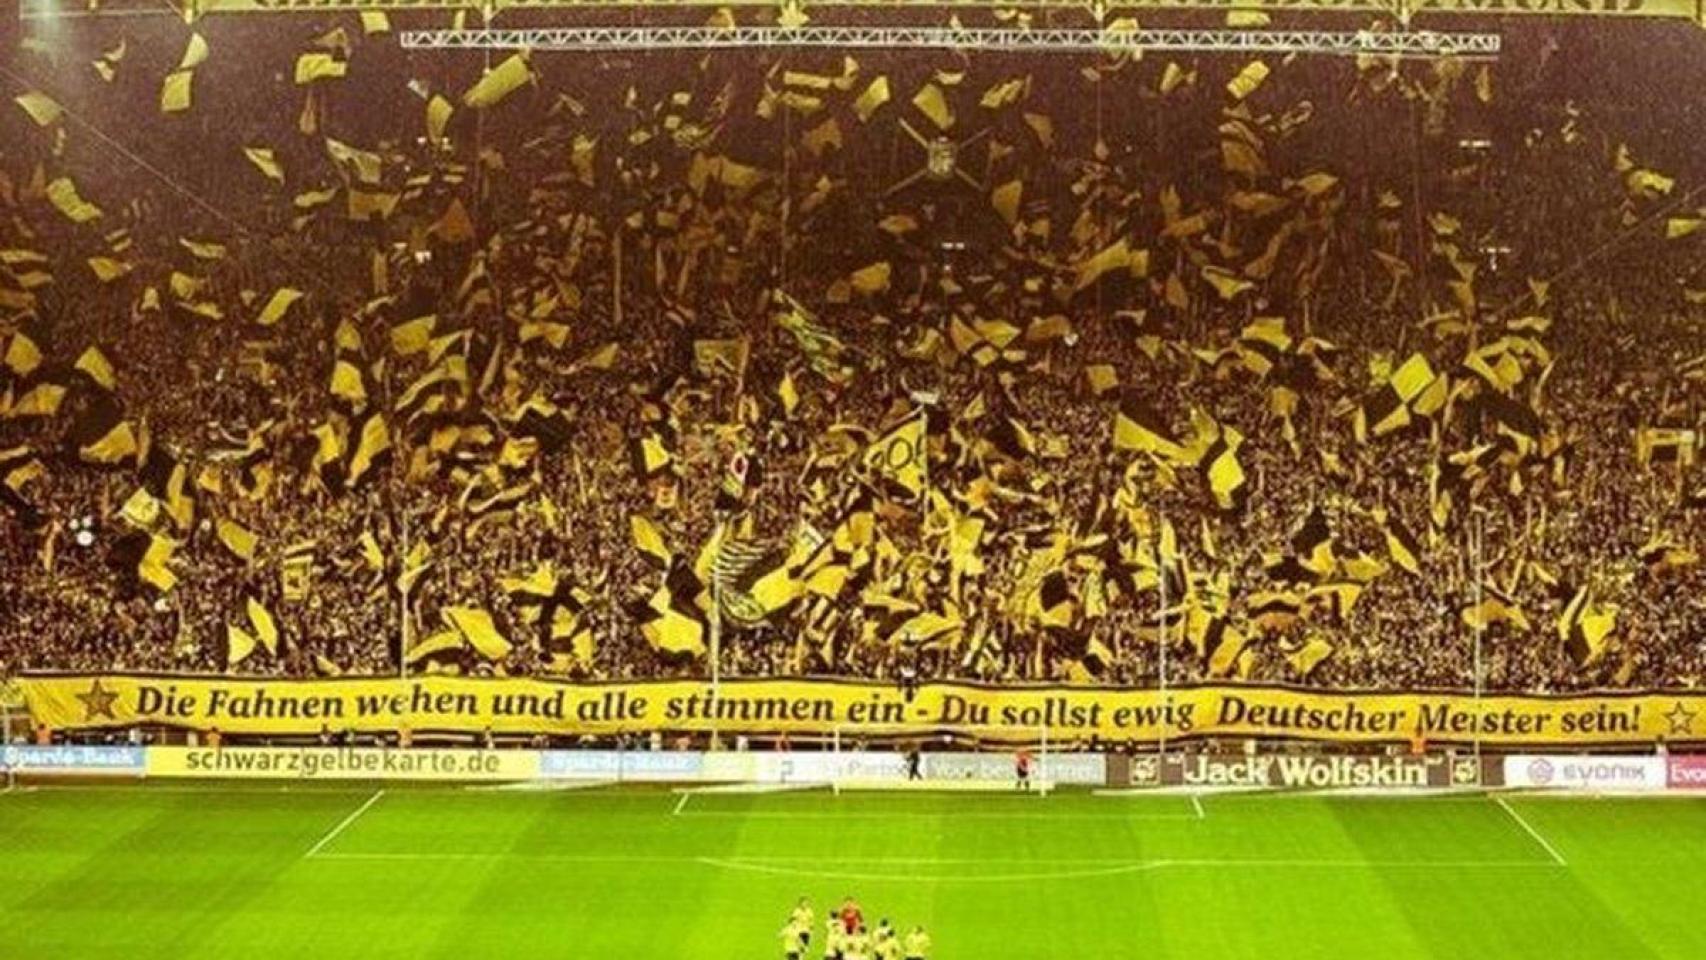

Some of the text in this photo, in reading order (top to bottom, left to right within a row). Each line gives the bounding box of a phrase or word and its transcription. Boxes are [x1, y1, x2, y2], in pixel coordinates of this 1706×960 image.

[135, 686, 197, 716] Die
[206, 688, 344, 718] Fahnen
[355, 684, 478, 716] wehen
[492, 689, 564, 719] und
[576, 691, 648, 721] alle
[664, 689, 834, 722] stimmen
[847, 693, 904, 723] ein
[939, 695, 989, 724] Du
[1001, 698, 1102, 728] sollst
[1113, 697, 1194, 731] ewig
[1217, 696, 1406, 732] Deutscher
[1418, 704, 1552, 734] Meister
[1561, 704, 1641, 733] sein!
[186, 750, 500, 777] schwarzgelbekarte.de
[1183, 755, 1427, 787] Jack Wolfskin
